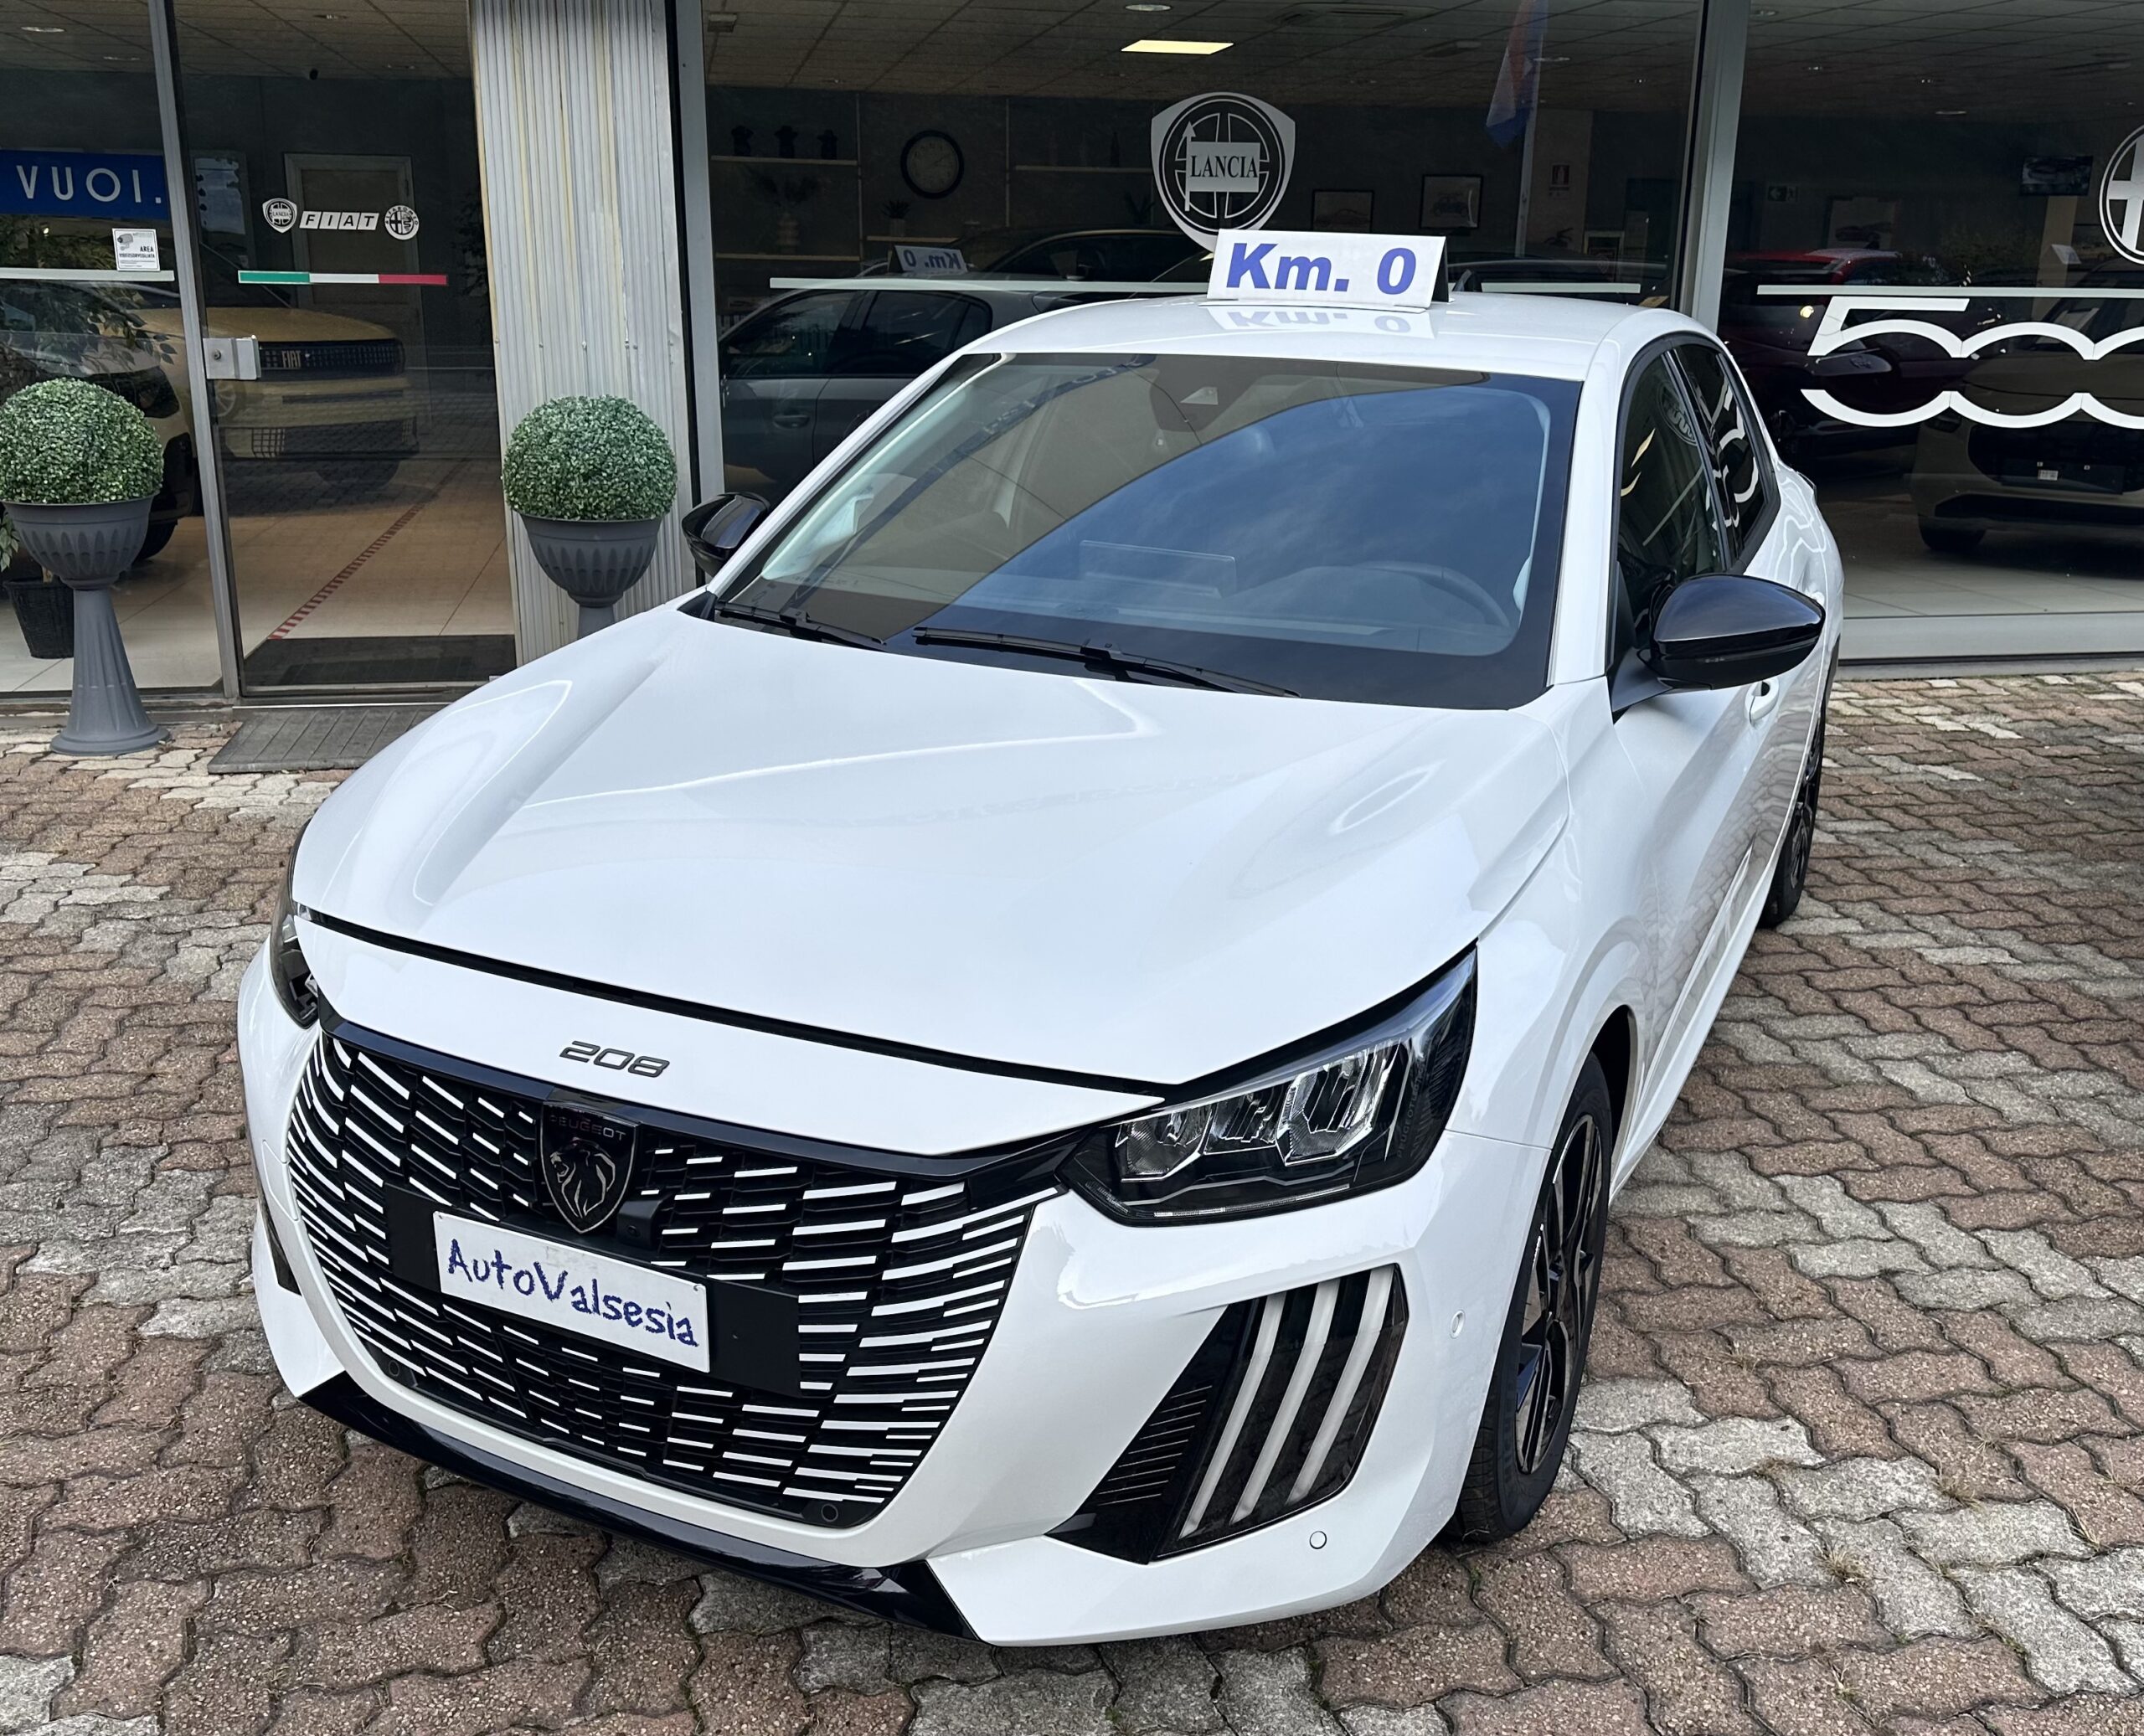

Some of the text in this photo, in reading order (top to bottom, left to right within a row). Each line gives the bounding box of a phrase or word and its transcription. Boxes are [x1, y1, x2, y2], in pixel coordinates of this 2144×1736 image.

[1190, 155, 1258, 178] LANCIA
[16, 164, 162, 203] VUOI.
[304, 214, 376, 228] FIAT
[1226, 242, 1416, 295] Km. 0
[281, 350, 302, 368] FIAT
[559, 1040, 670, 1078] 208
[549, 1114, 626, 1141] PEUGEOT
[448, 1238, 699, 1347] AutoValsesia
